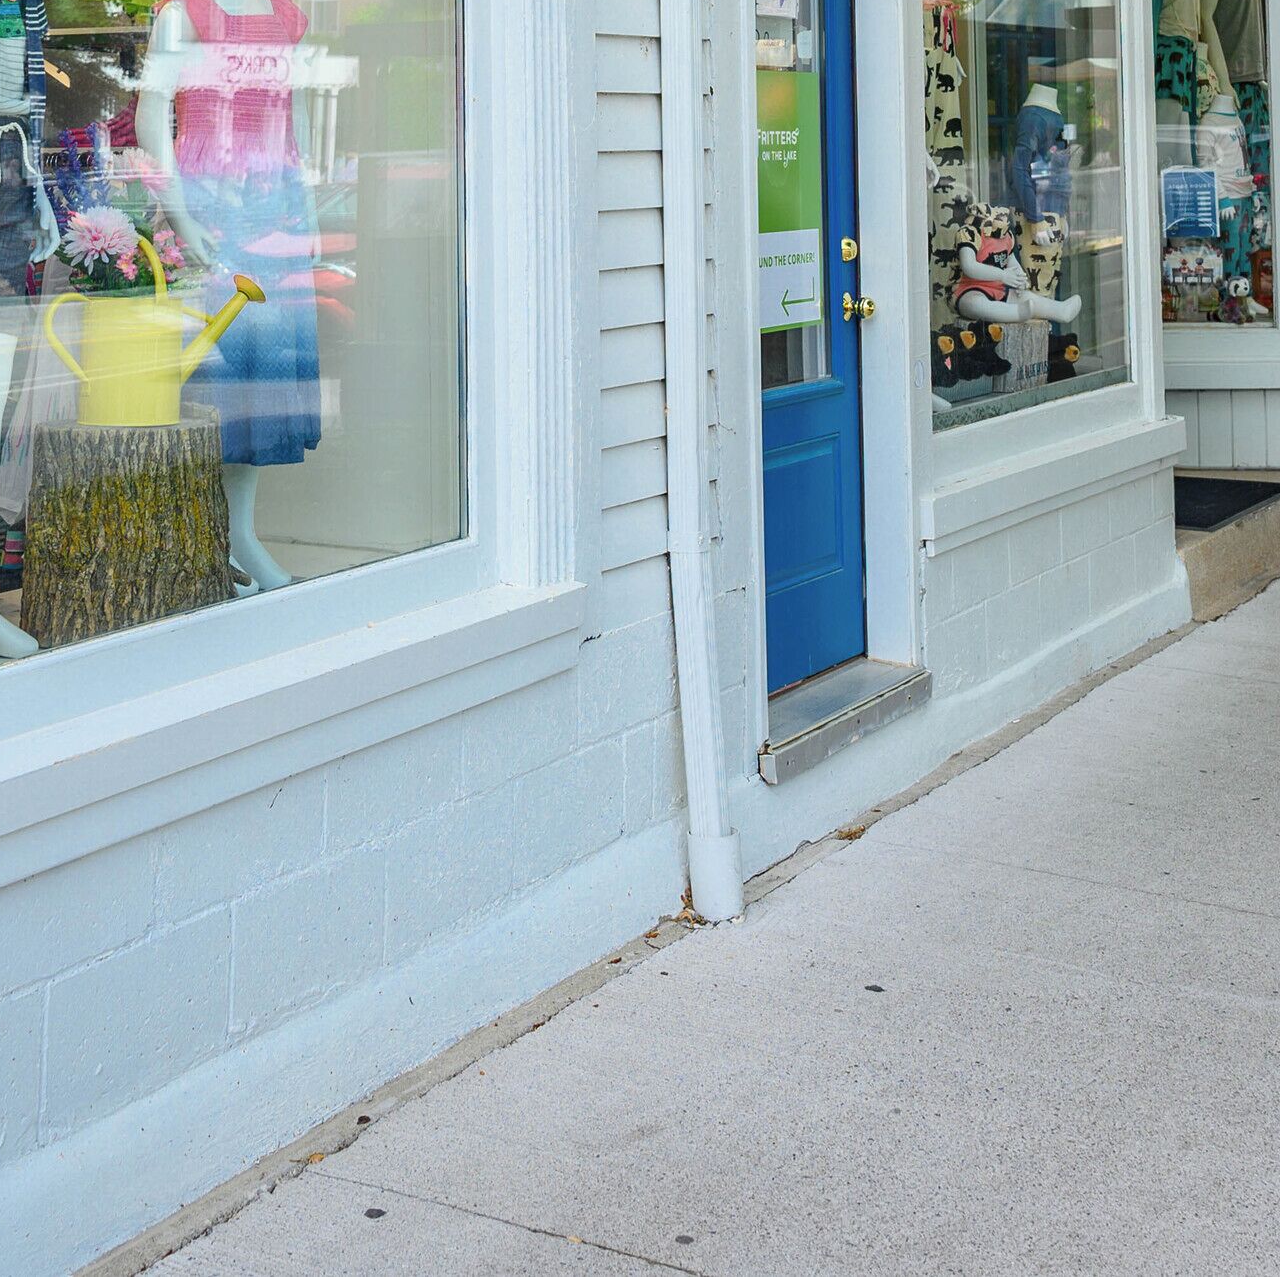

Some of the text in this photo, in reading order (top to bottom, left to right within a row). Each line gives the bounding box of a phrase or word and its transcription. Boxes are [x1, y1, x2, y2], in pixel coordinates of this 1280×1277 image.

[762, 149, 797, 169] ON THE LAKE
[774, 254, 787, 267] THE
